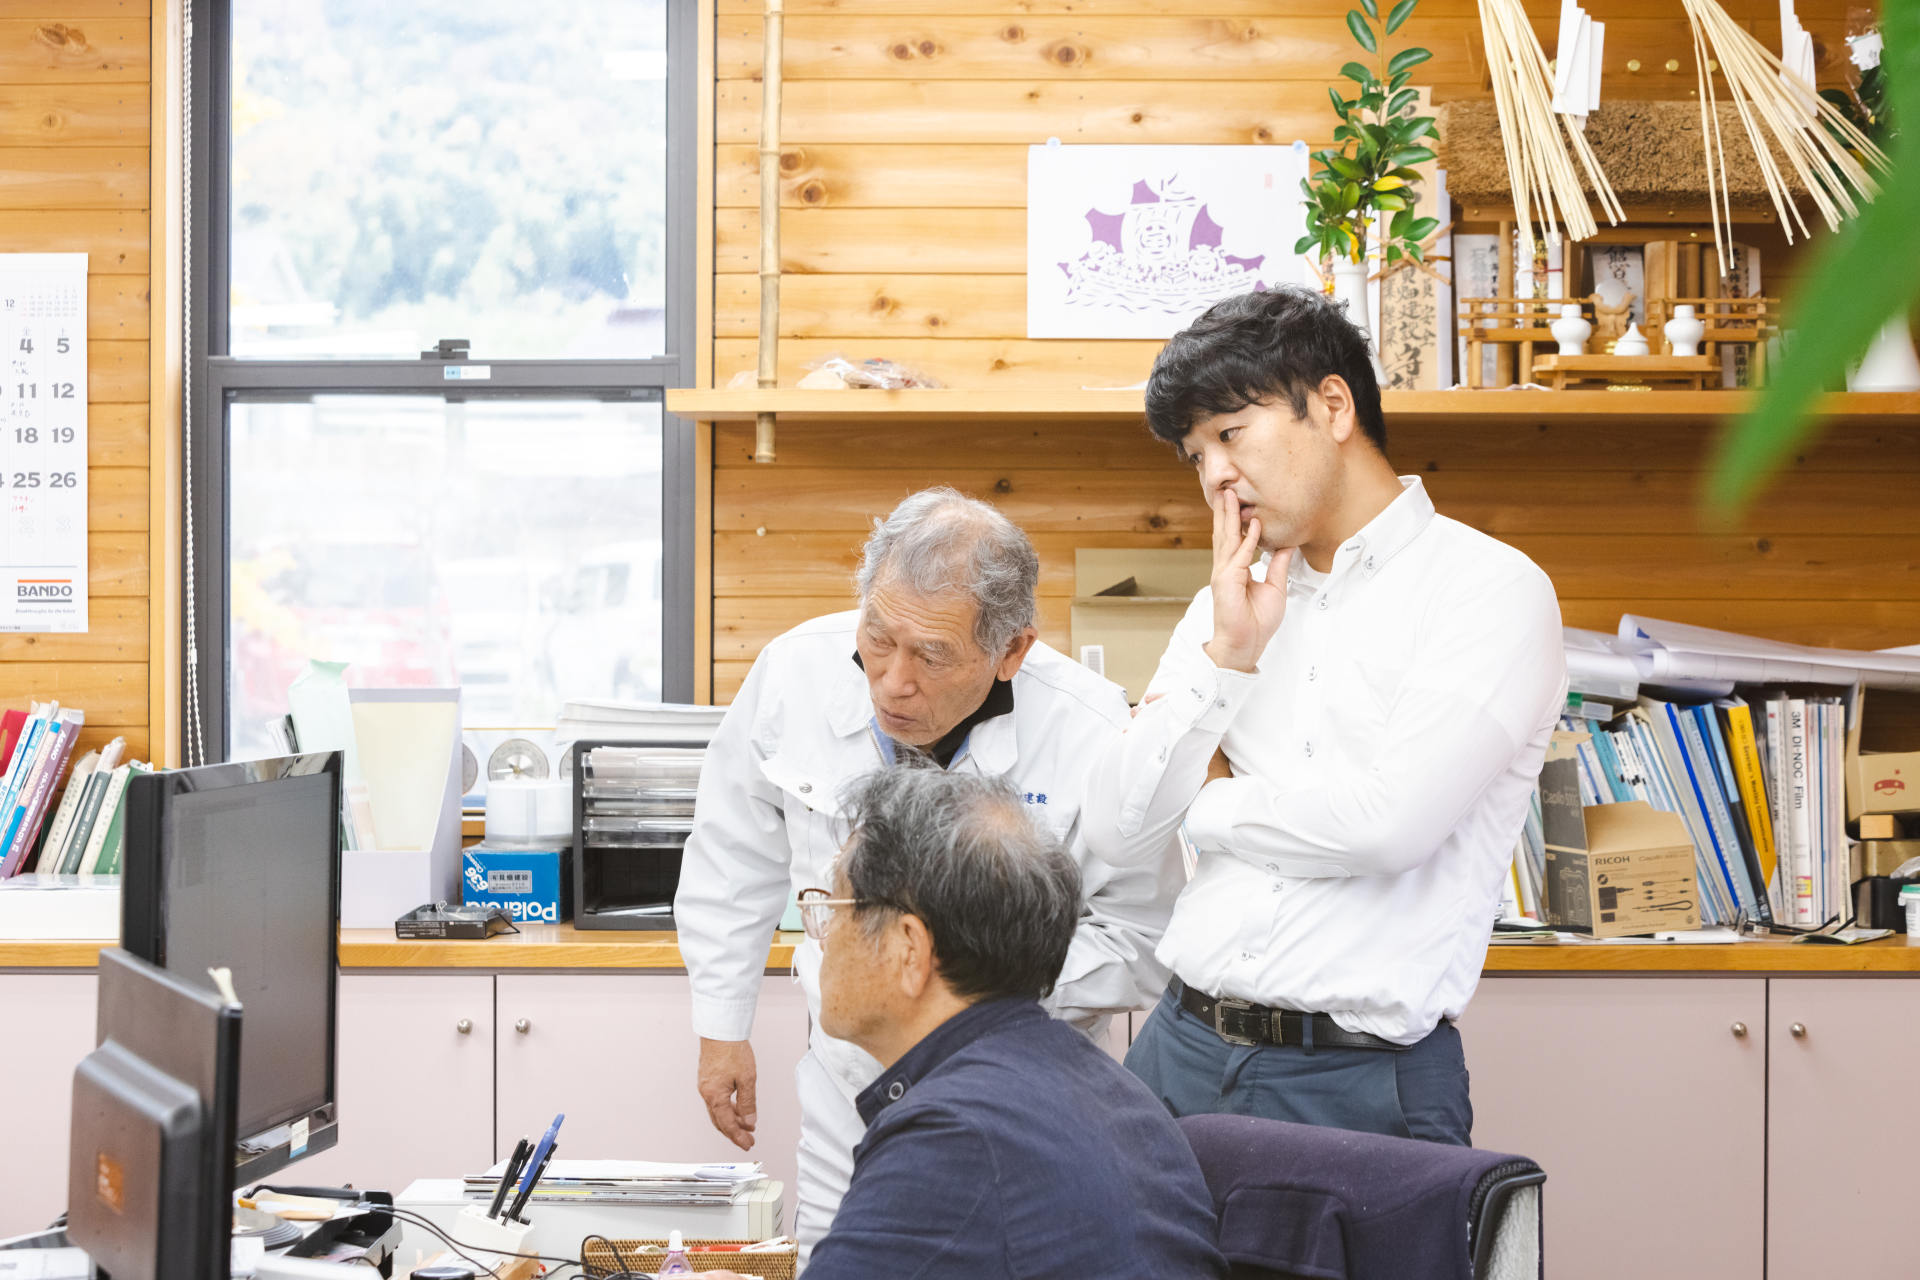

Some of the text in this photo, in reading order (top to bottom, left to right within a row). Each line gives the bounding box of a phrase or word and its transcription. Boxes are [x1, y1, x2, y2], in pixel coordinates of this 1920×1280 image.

[5, 298, 15, 308] 12
[19, 337, 70, 354] 4 5
[17, 382, 75, 399] 11 12
[15, 426, 75, 444] 18 19
[12, 471, 77, 488] 25 26
[17, 585, 73, 597] BANDO
[1791, 711, 1804, 809] 3M DI-NOC Film
[1595, 856, 1630, 865] RICOH
[464, 867, 489, 890] 636
[465, 901, 557, 921] Polar
